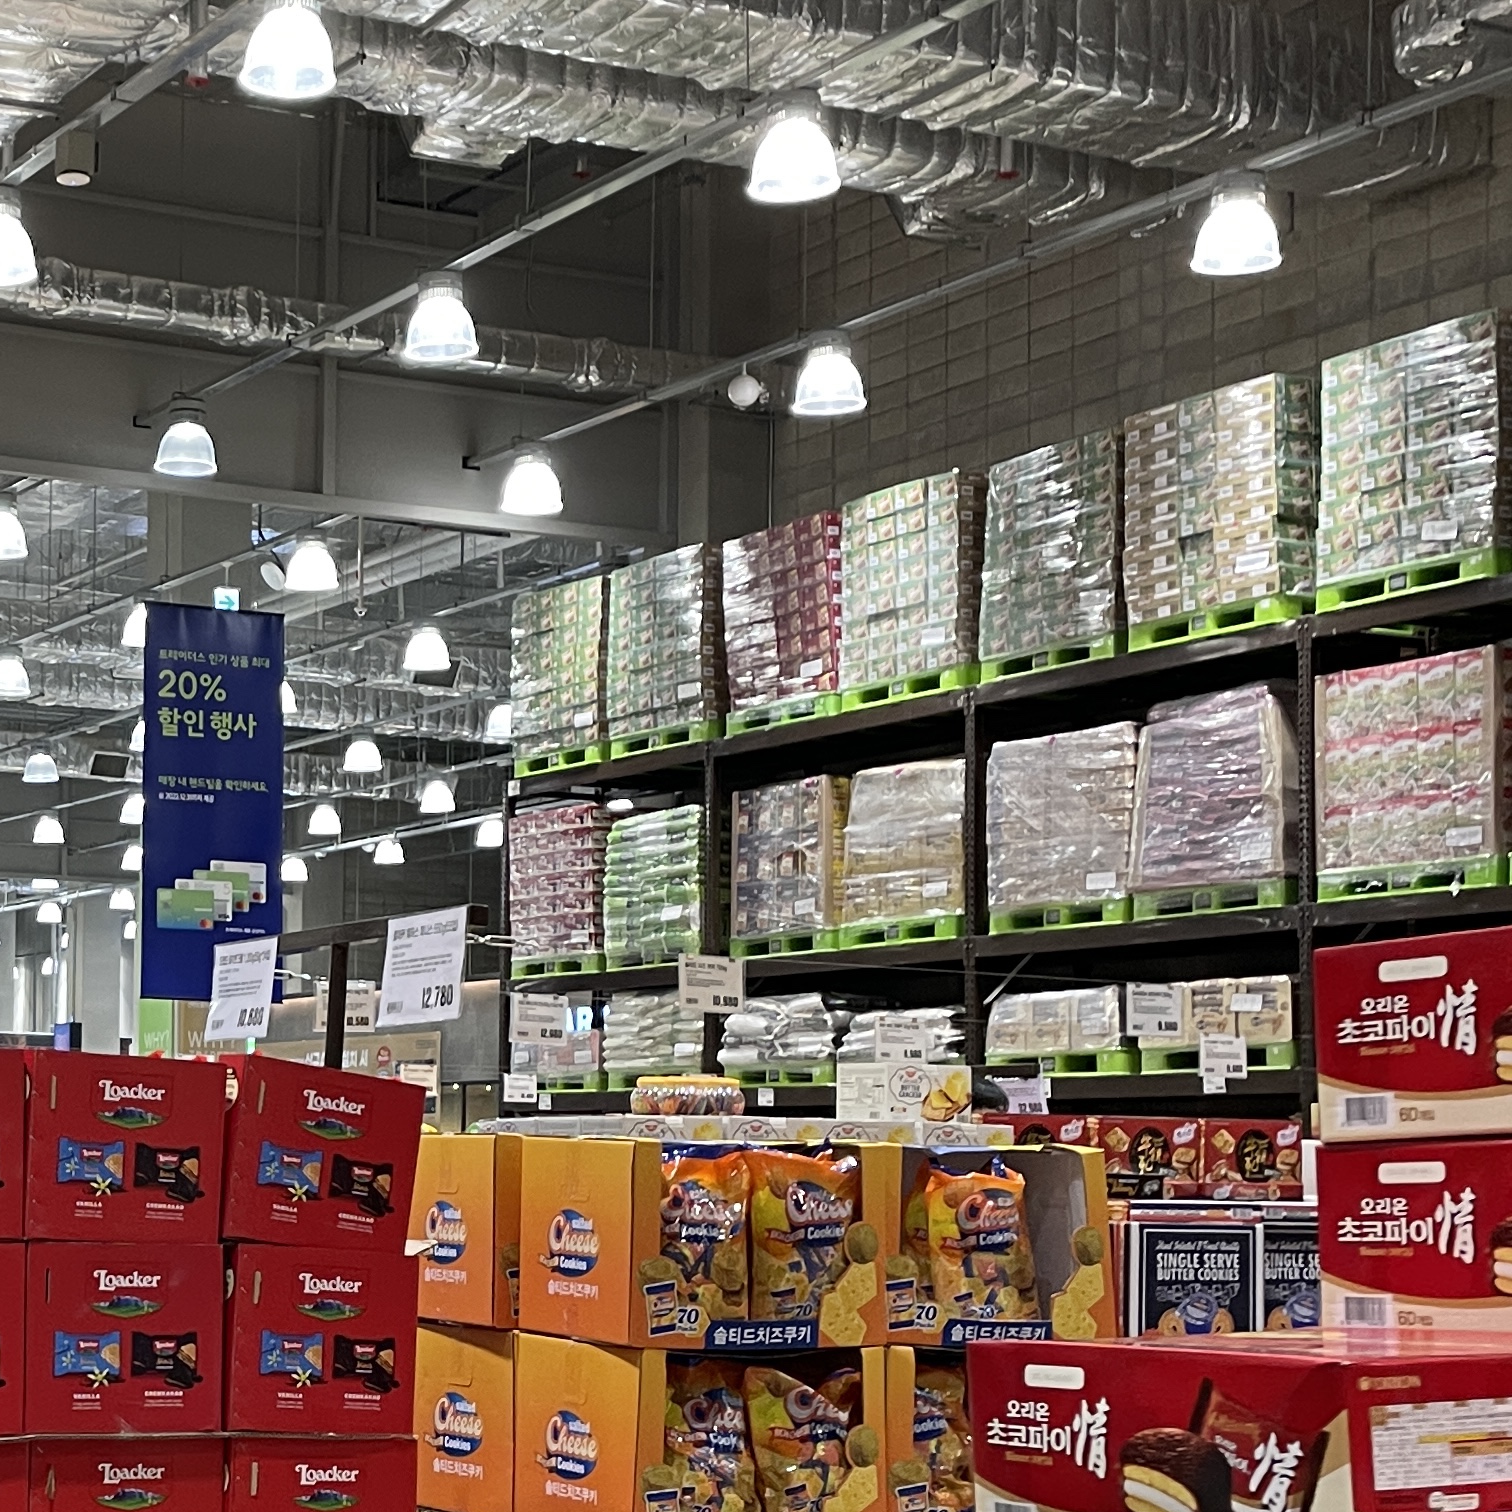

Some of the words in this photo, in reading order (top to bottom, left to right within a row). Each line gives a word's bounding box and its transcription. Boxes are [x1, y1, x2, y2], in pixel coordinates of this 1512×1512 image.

[158, 669, 227, 702] 20%
[157, 706, 205, 738] 할인
[210, 711, 258, 741] 행사
[422, 984, 454, 1009] 12,780
[1360, 995, 1410, 1015] 오리온
[1337, 1012, 1435, 1044] 초코파이
[98, 1078, 166, 1103] Loacker
[304, 1089, 366, 1117] Loacker
[1360, 1198, 1409, 1216] 오리온
[549, 1213, 600, 1254] Cheese
[1337, 1217, 1434, 1245] 초코파이
[1157, 1253, 1199, 1268] SINGLE
[1204, 1253, 1240, 1268] SERVE
[1264, 1253, 1304, 1268] SINGLE
[93, 1268, 161, 1292] Loacker
[298, 1272, 363, 1296] Loacker
[1157, 1268, 1195, 1281] BUTTER
[1198, 1268, 1240, 1281] COOKIES
[1265, 1267, 1300, 1280] BUTTER
[677, 1308, 699, 1324] 70
[916, 1305, 937, 1320] 70
[713, 1325, 812, 1345] 솔티드치즈쿠키
[951, 1324, 1046, 1342] 솔티드치즈쿠키
[434, 1397, 483, 1437] Cheese
[1006, 1400, 1050, 1421] 오리온
[546, 1416, 598, 1459] Cheese
[987, 1418, 1071, 1456] 초코파이
[98, 1462, 166, 1486] Loacker
[295, 1464, 360, 1487] Loacker
